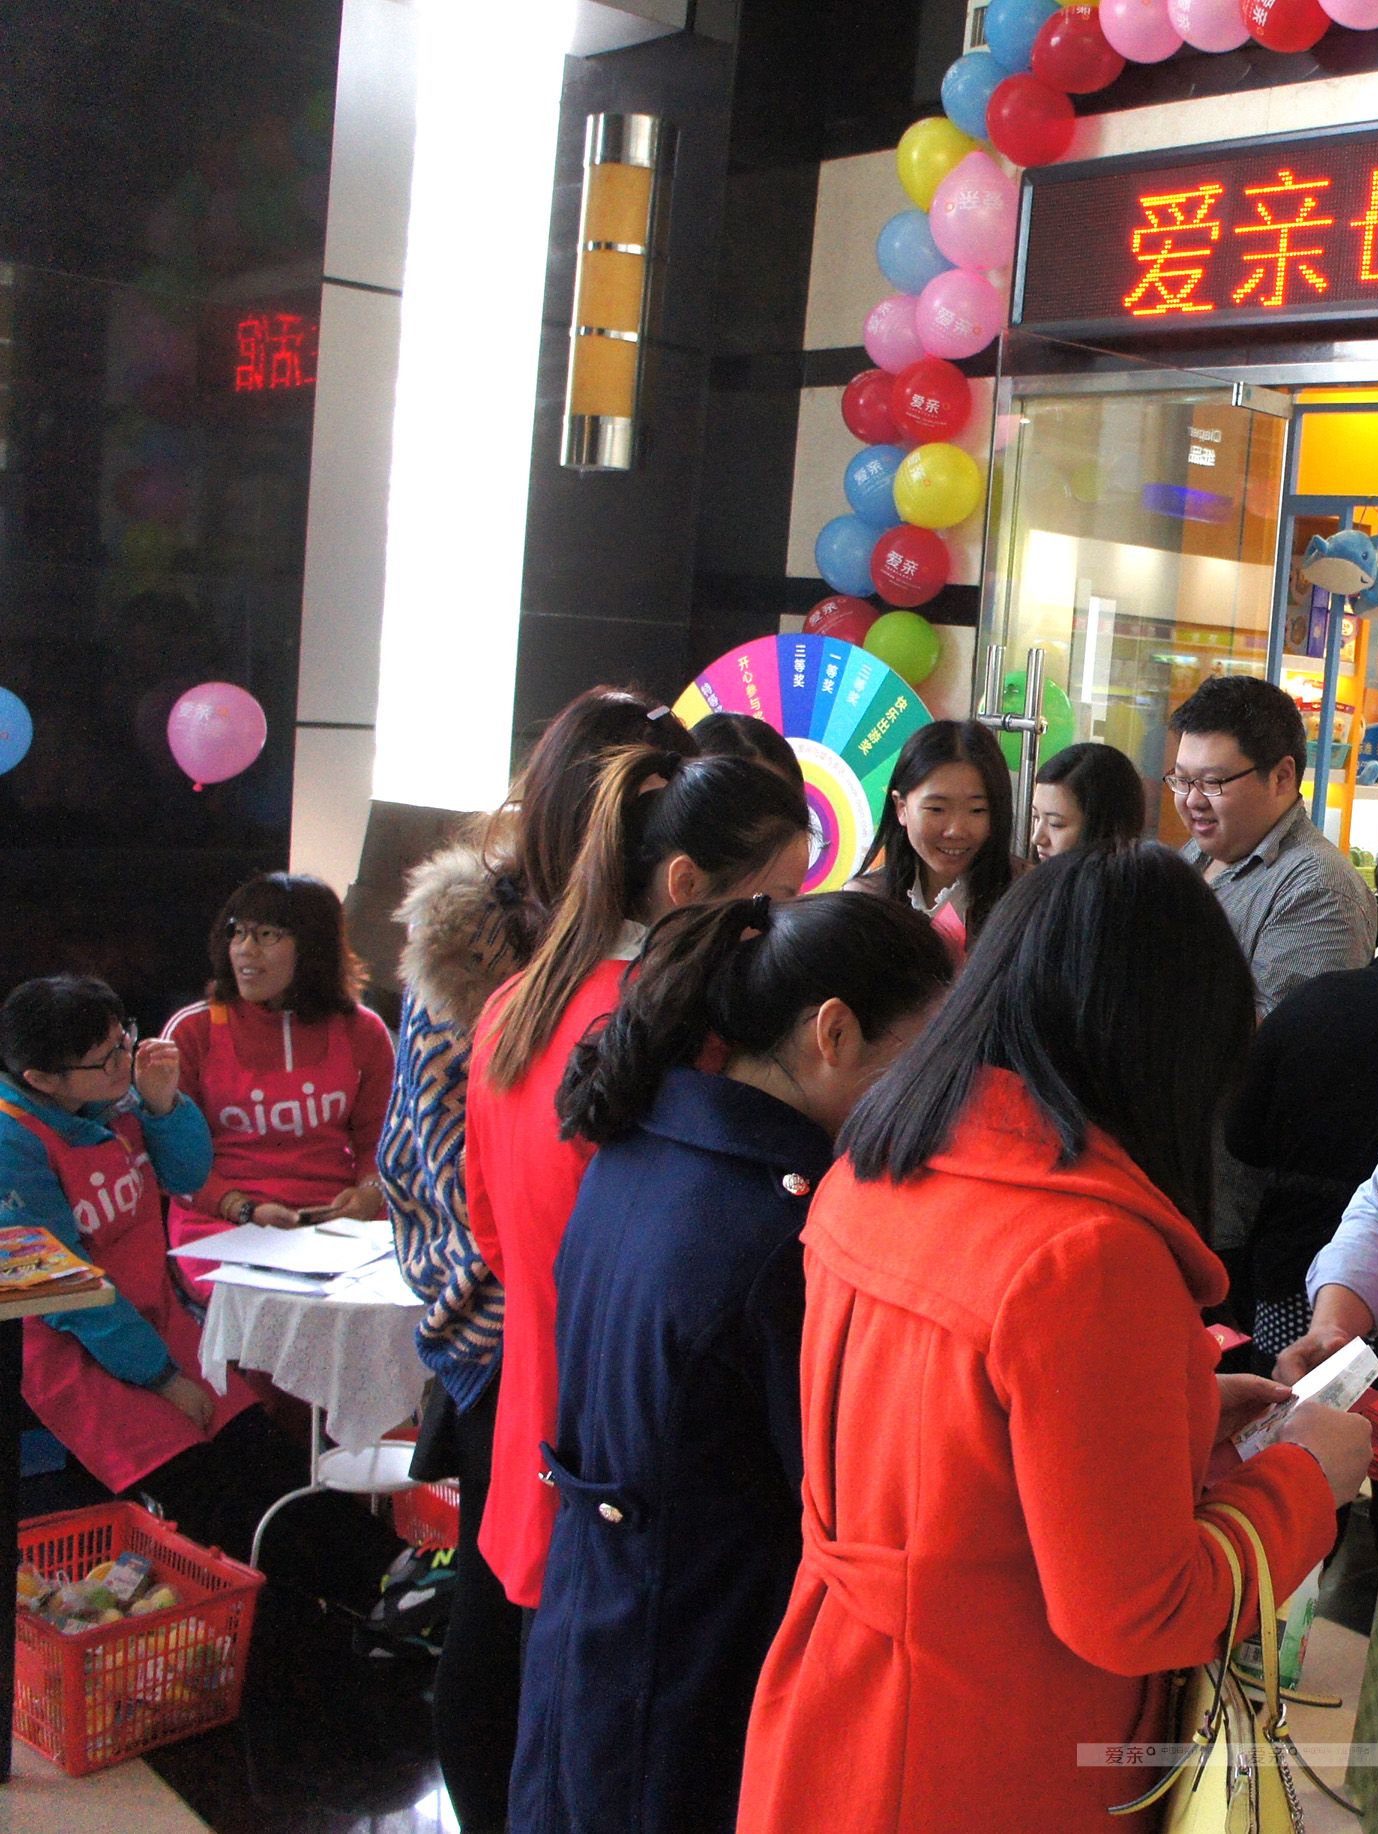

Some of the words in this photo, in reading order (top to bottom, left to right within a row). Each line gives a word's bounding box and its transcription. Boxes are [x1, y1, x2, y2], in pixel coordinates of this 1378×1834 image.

[911, 394, 940, 413] 爱亲
[886, 550, 918, 576] 爱亲
[793, 645, 806, 688] 三等奖
[822, 653, 841, 694] 一等奖
[219, 1082, 347, 1137] aiqin
